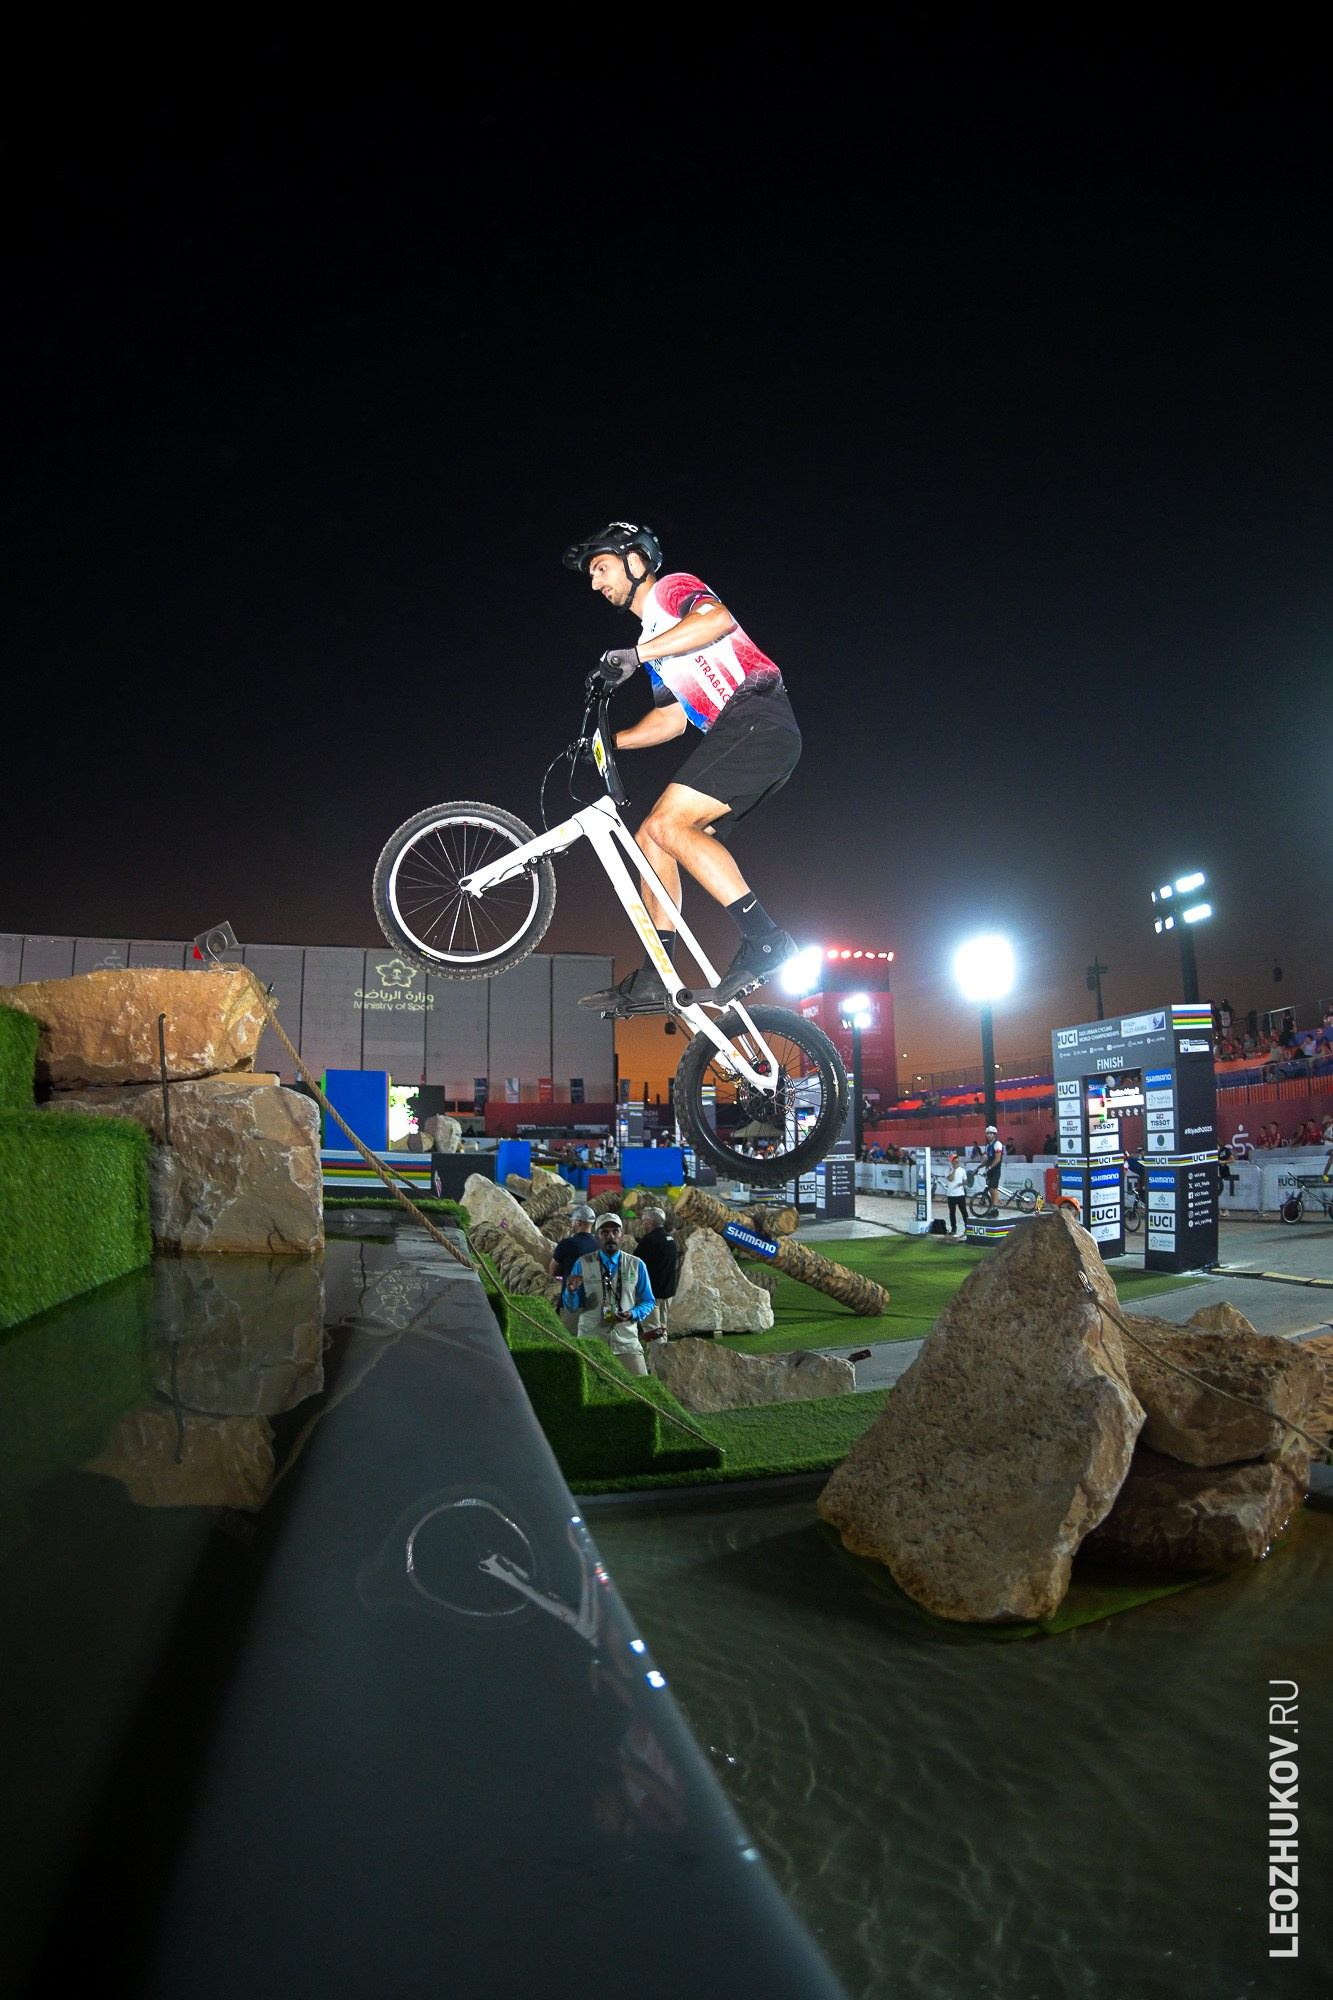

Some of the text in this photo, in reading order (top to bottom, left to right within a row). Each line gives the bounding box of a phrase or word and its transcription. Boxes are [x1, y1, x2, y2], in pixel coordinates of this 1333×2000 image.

[695, 655, 731, 703] STRABAG
[631, 904, 673, 974] CLEAN
[354, 988, 434, 1003] وزارة الرياضة
[353, 1001, 434, 1012] Ministry of Sport
[1061, 1033, 1077, 1046] UCI
[1097, 1056, 1124, 1070] FINISH
[1146, 1073, 1172, 1083] SHIMANO
[1062, 1084, 1077, 1095] UCI
[1150, 1119, 1171, 1127] TISSOT
[1184, 1125, 1213, 1136] #Riyadh2025
[1098, 1157, 1111, 1165] UCI
[1193, 1154, 1206, 1162] UCI
[1061, 1175, 1083, 1183] SHIMANO
[1091, 1173, 1120, 1183] SHIMANO
[1149, 1176, 1175, 1184] SHIMANO
[803, 1183, 815, 1191] UC
[1096, 1208, 1117, 1221] UCI
[1153, 1216, 1173, 1228] UCI
[973, 1227, 986, 1235] UCI
[726, 1226, 777, 1254] SHIMANO
